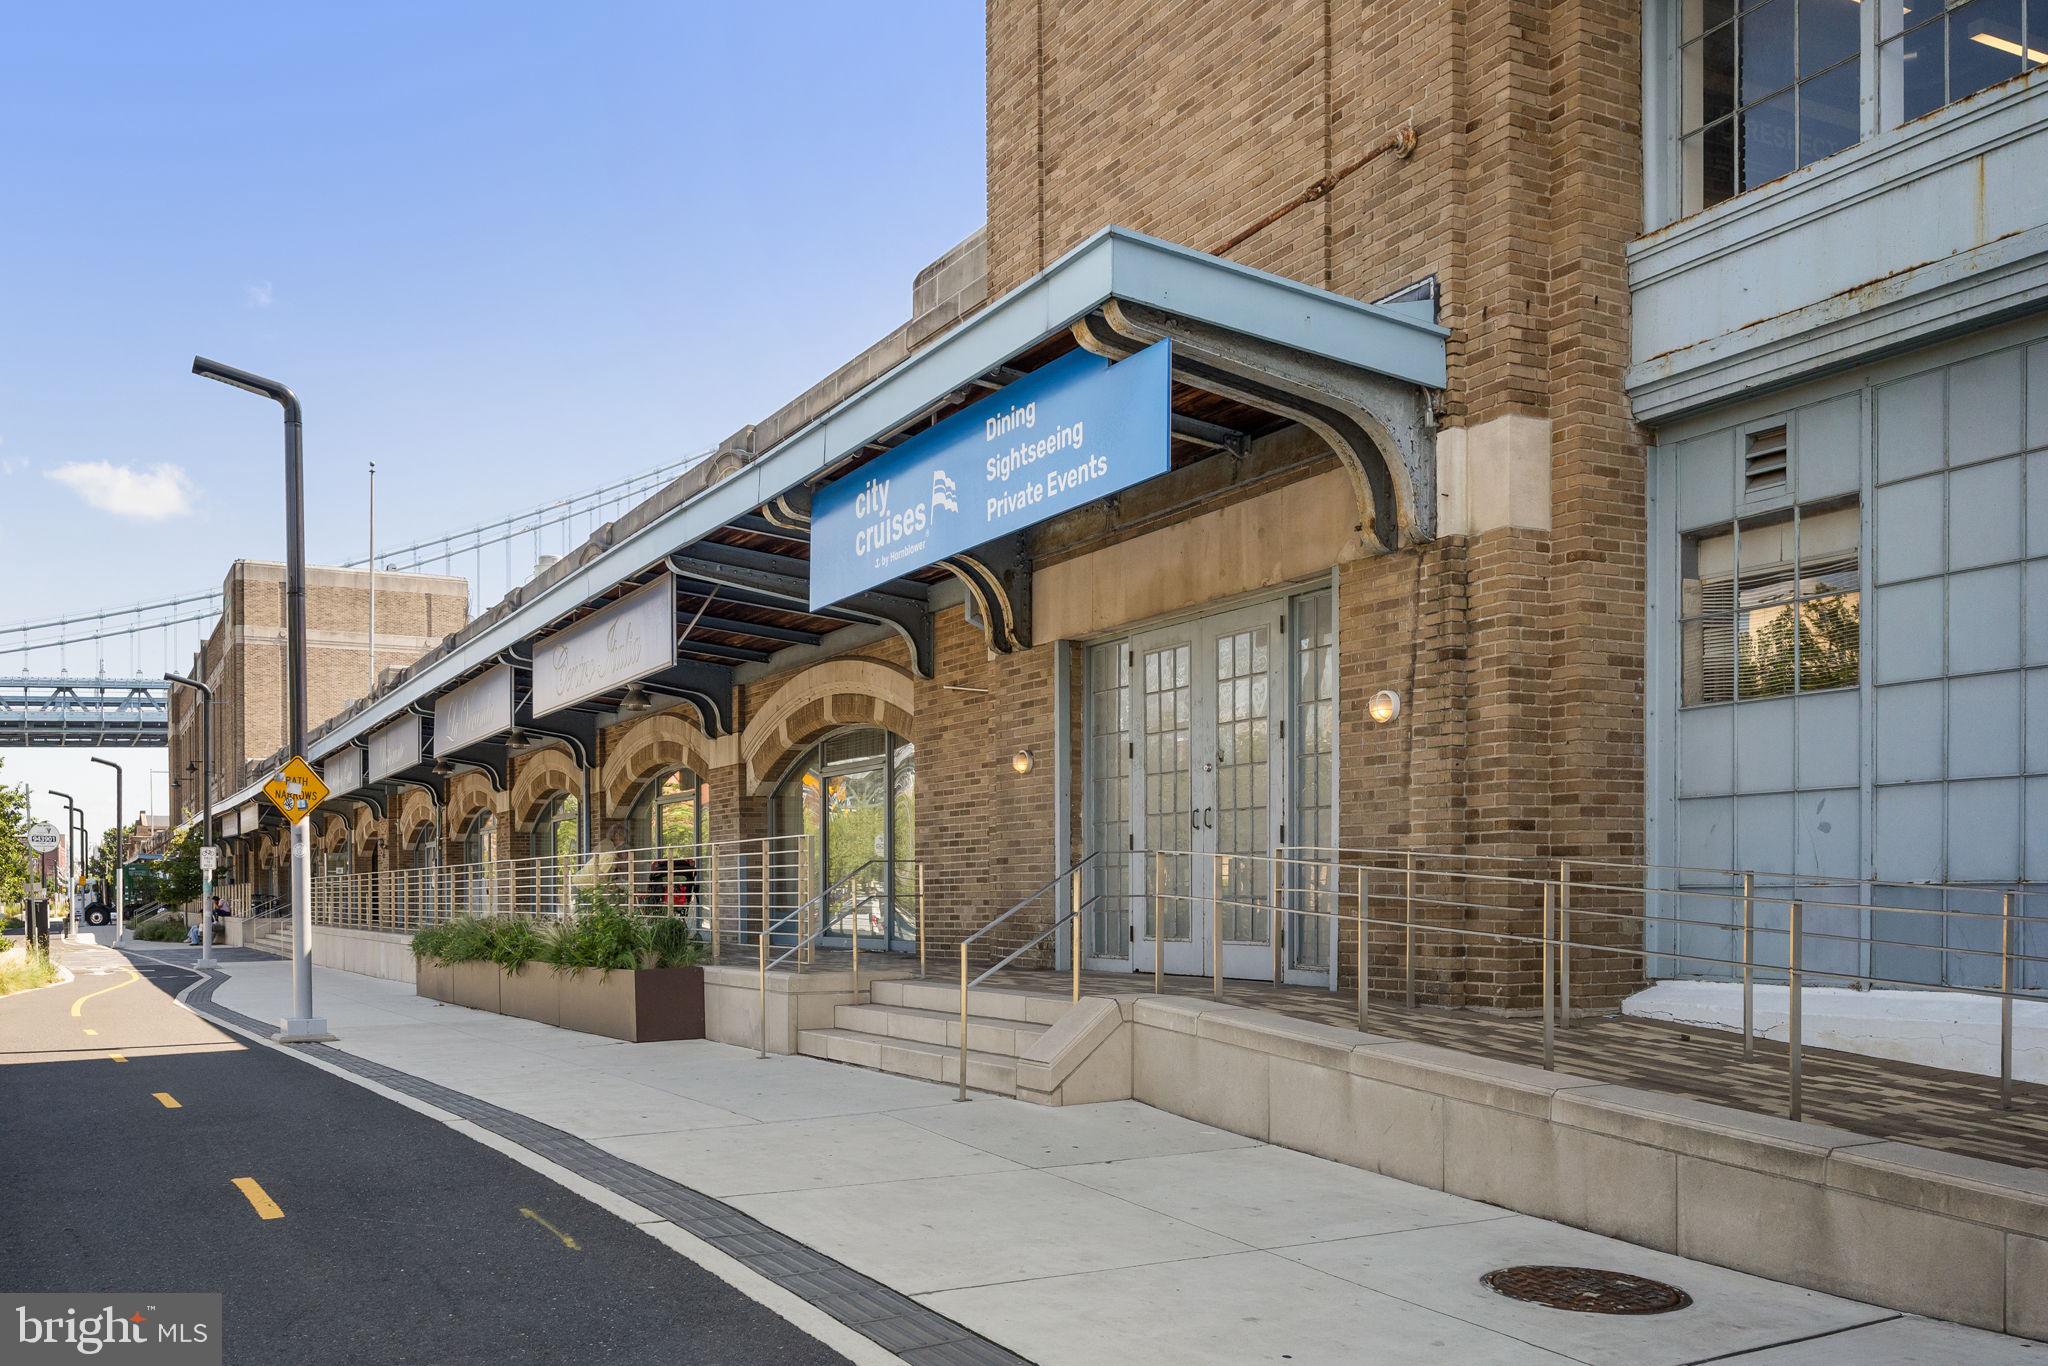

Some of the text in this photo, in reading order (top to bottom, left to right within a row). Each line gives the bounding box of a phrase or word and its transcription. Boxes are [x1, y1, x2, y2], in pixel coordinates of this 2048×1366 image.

[986, 401, 1036, 442] Dining
[986, 421, 1083, 481] Sightseeing
[855, 478, 890, 519] city
[986, 454, 1108, 522] Private Events
[855, 509, 927, 557] cruises
[881, 540, 926, 567] by Hornblower
